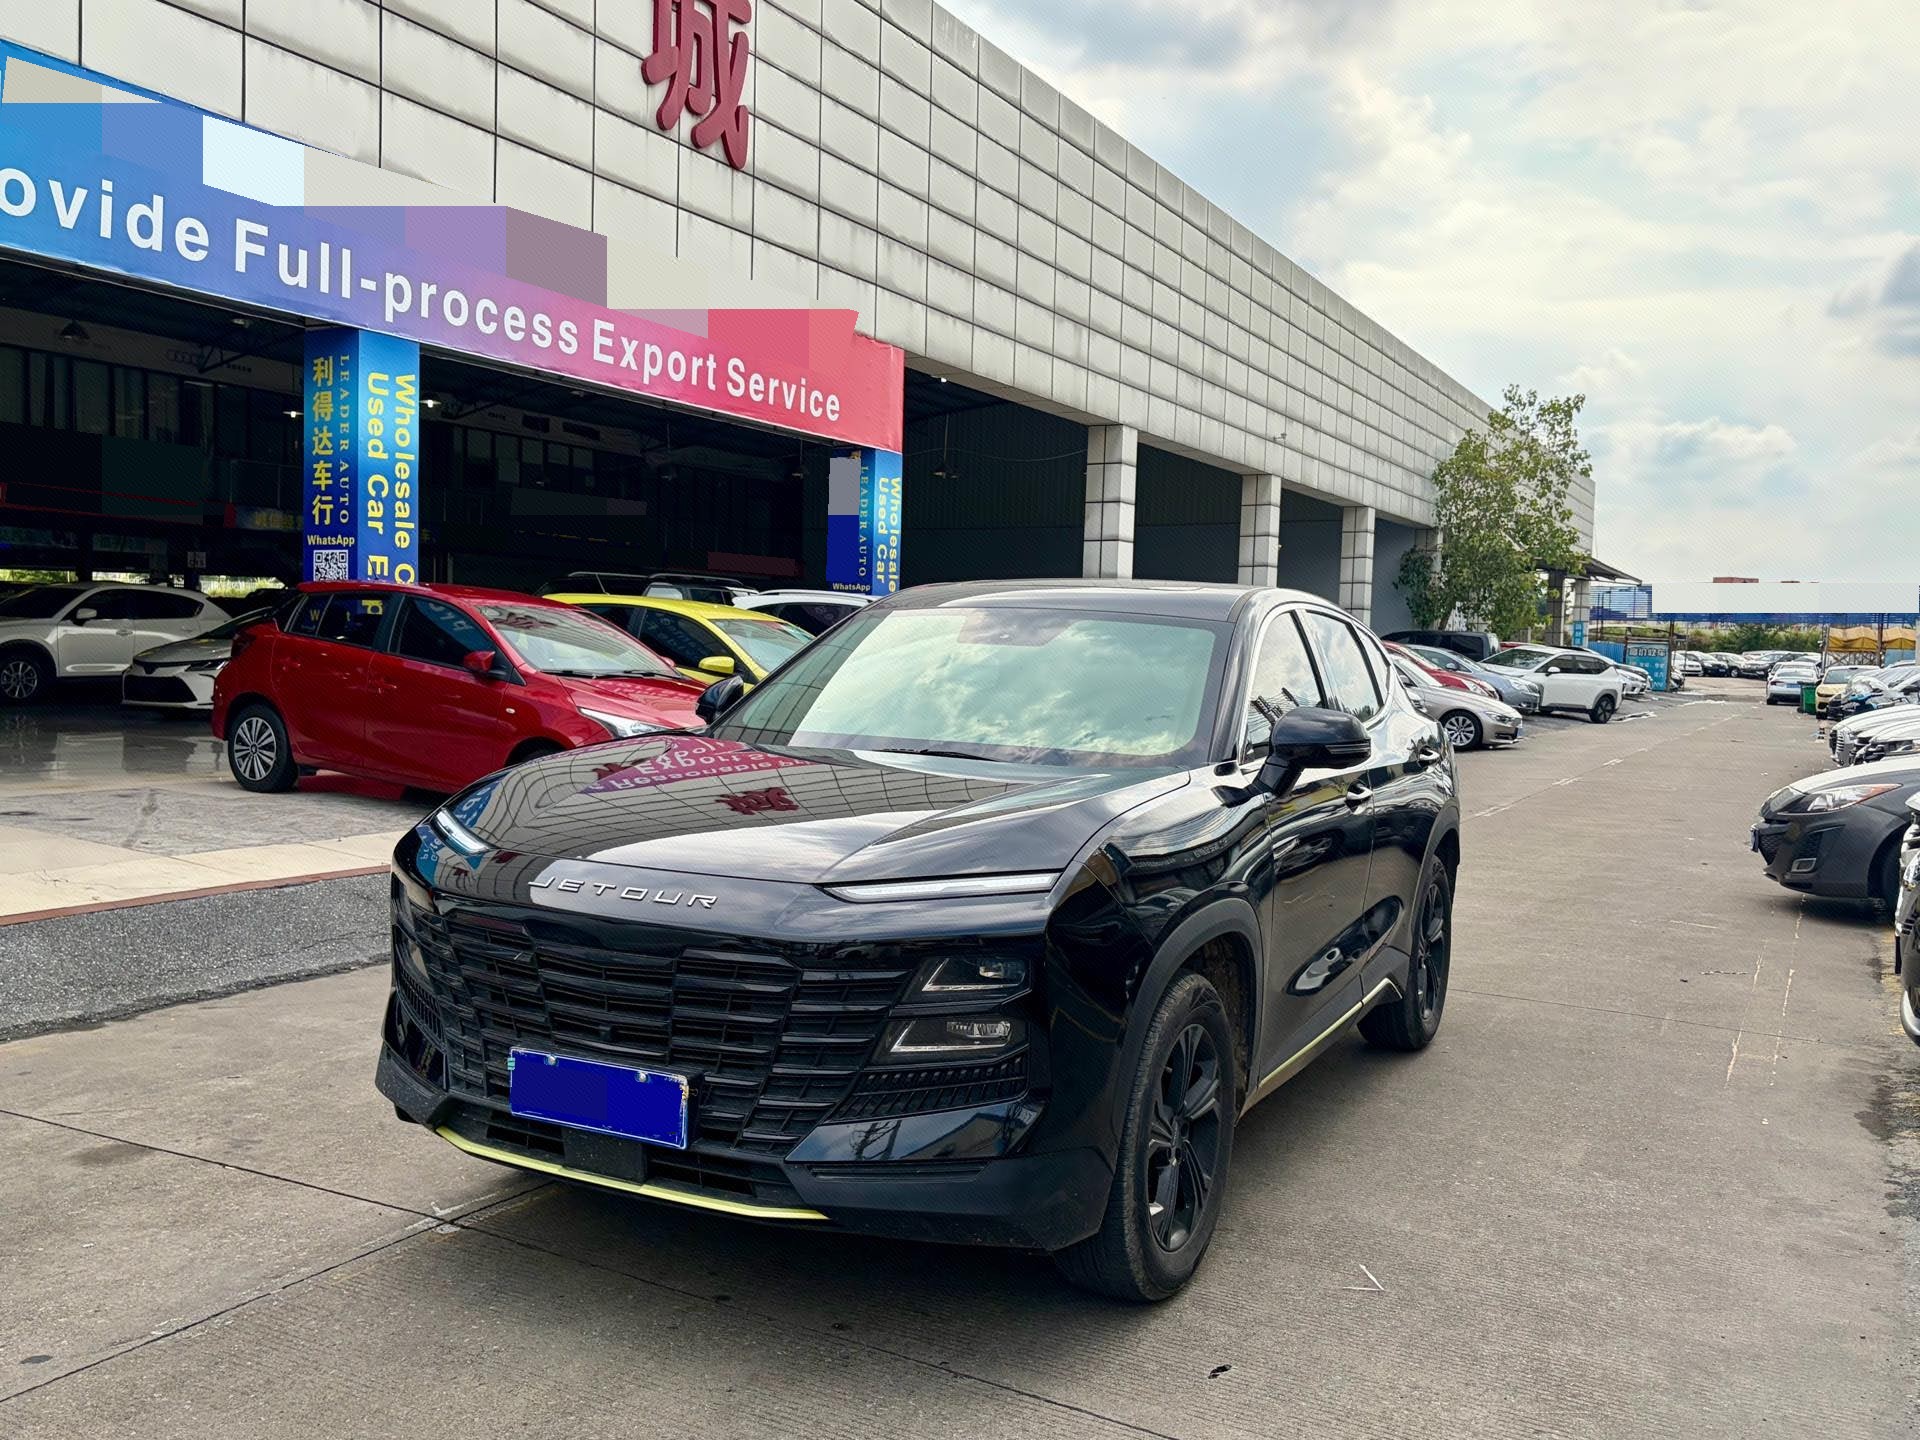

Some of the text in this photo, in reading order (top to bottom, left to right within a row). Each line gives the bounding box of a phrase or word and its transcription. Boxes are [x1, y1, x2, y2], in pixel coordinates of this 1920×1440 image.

[640, 0, 752, 170] 城
[0, 167, 841, 422] ovide Full-process Export Service
[312, 355, 334, 525] 利得达车行
[339, 354, 350, 524] LEADER AUTO
[367, 371, 389, 460] Used
[394, 373, 416, 549] Wholesale
[307, 534, 355, 547] WhatsApp
[367, 473, 389, 536] Car
[858, 465, 869, 577] LEADER AUTO
[876, 476, 889, 584] Used Car
[888, 476, 902, 593] Wholesale
[832, 582, 871, 592] WhatsApp
[527, 875, 719, 910] JETOUR
